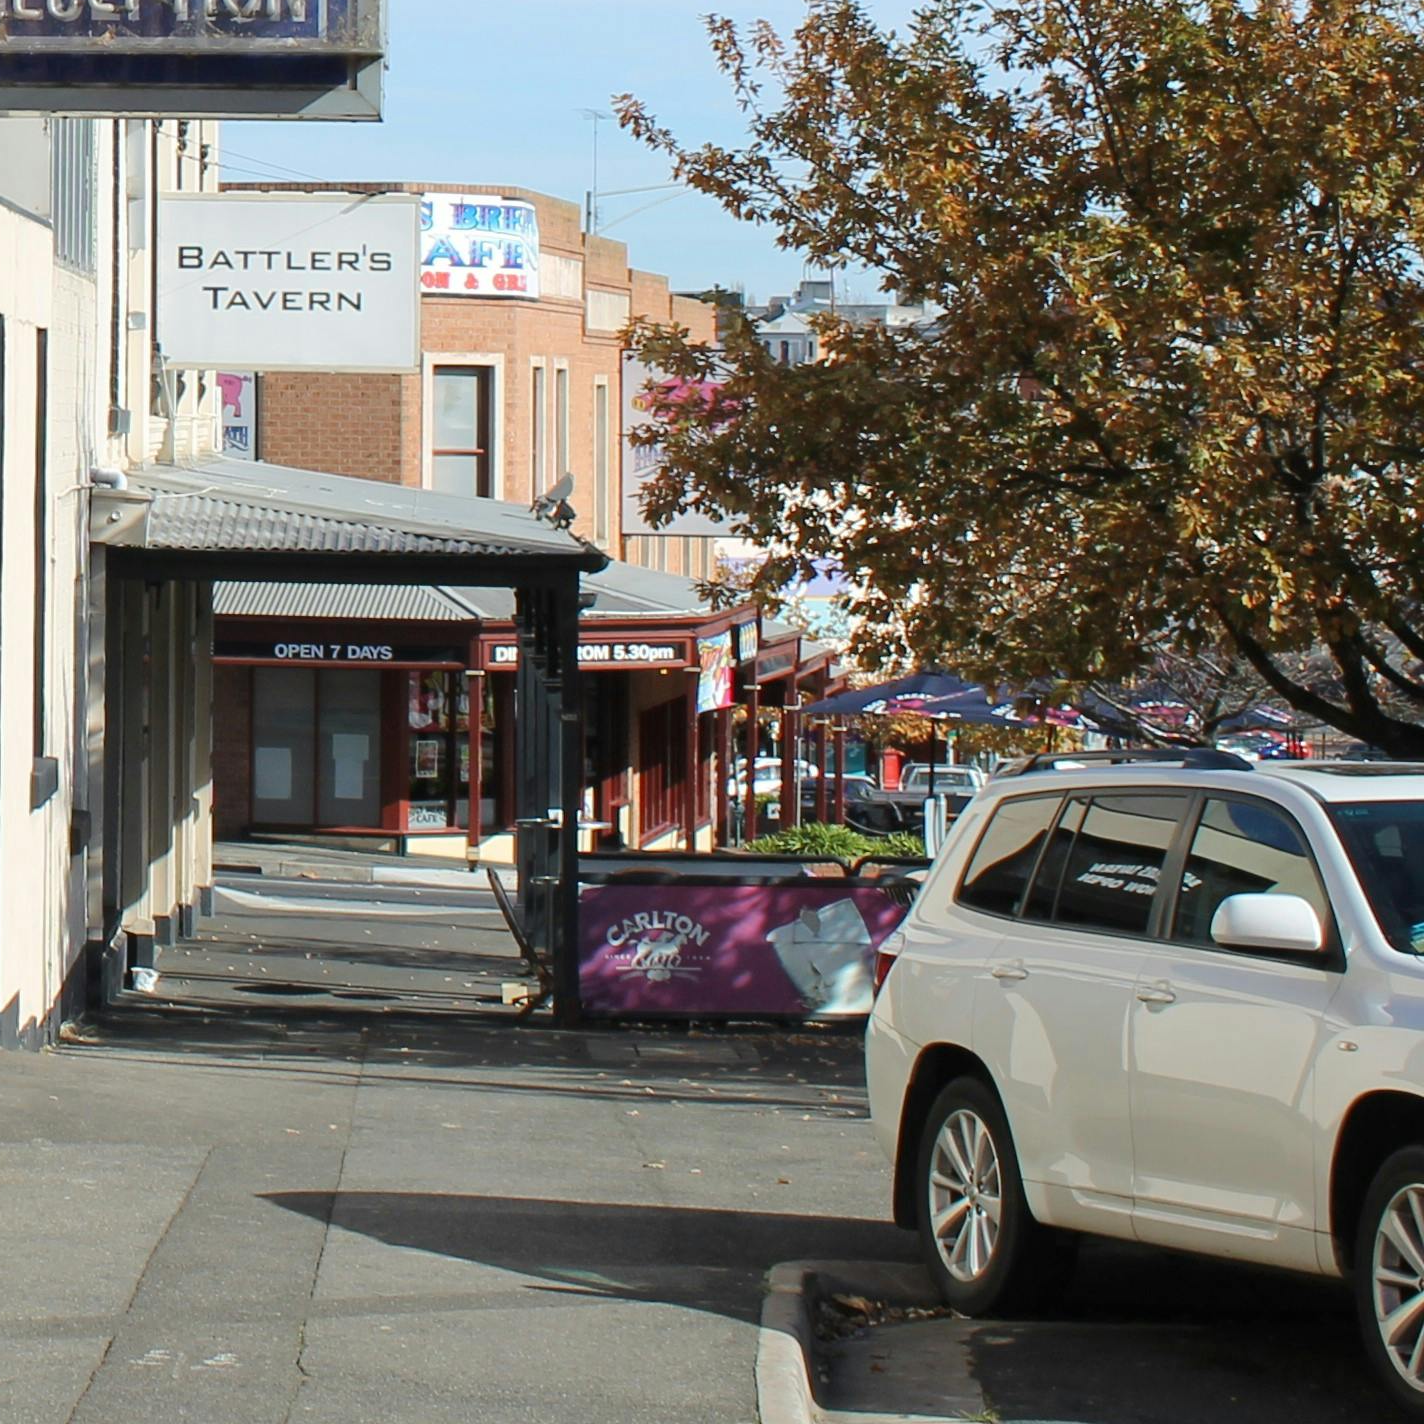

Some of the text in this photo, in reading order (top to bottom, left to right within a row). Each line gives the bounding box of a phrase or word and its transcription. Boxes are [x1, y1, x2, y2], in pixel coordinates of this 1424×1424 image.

[177, 243, 393, 272] BATTLER'S
[420, 234, 524, 270] AFE
[202, 285, 362, 312] TAVERN
[274, 643, 393, 660] OPEN 7 DAYS
[613, 643, 675, 662] 5.30pm
[606, 910, 711, 947] CARLTON
